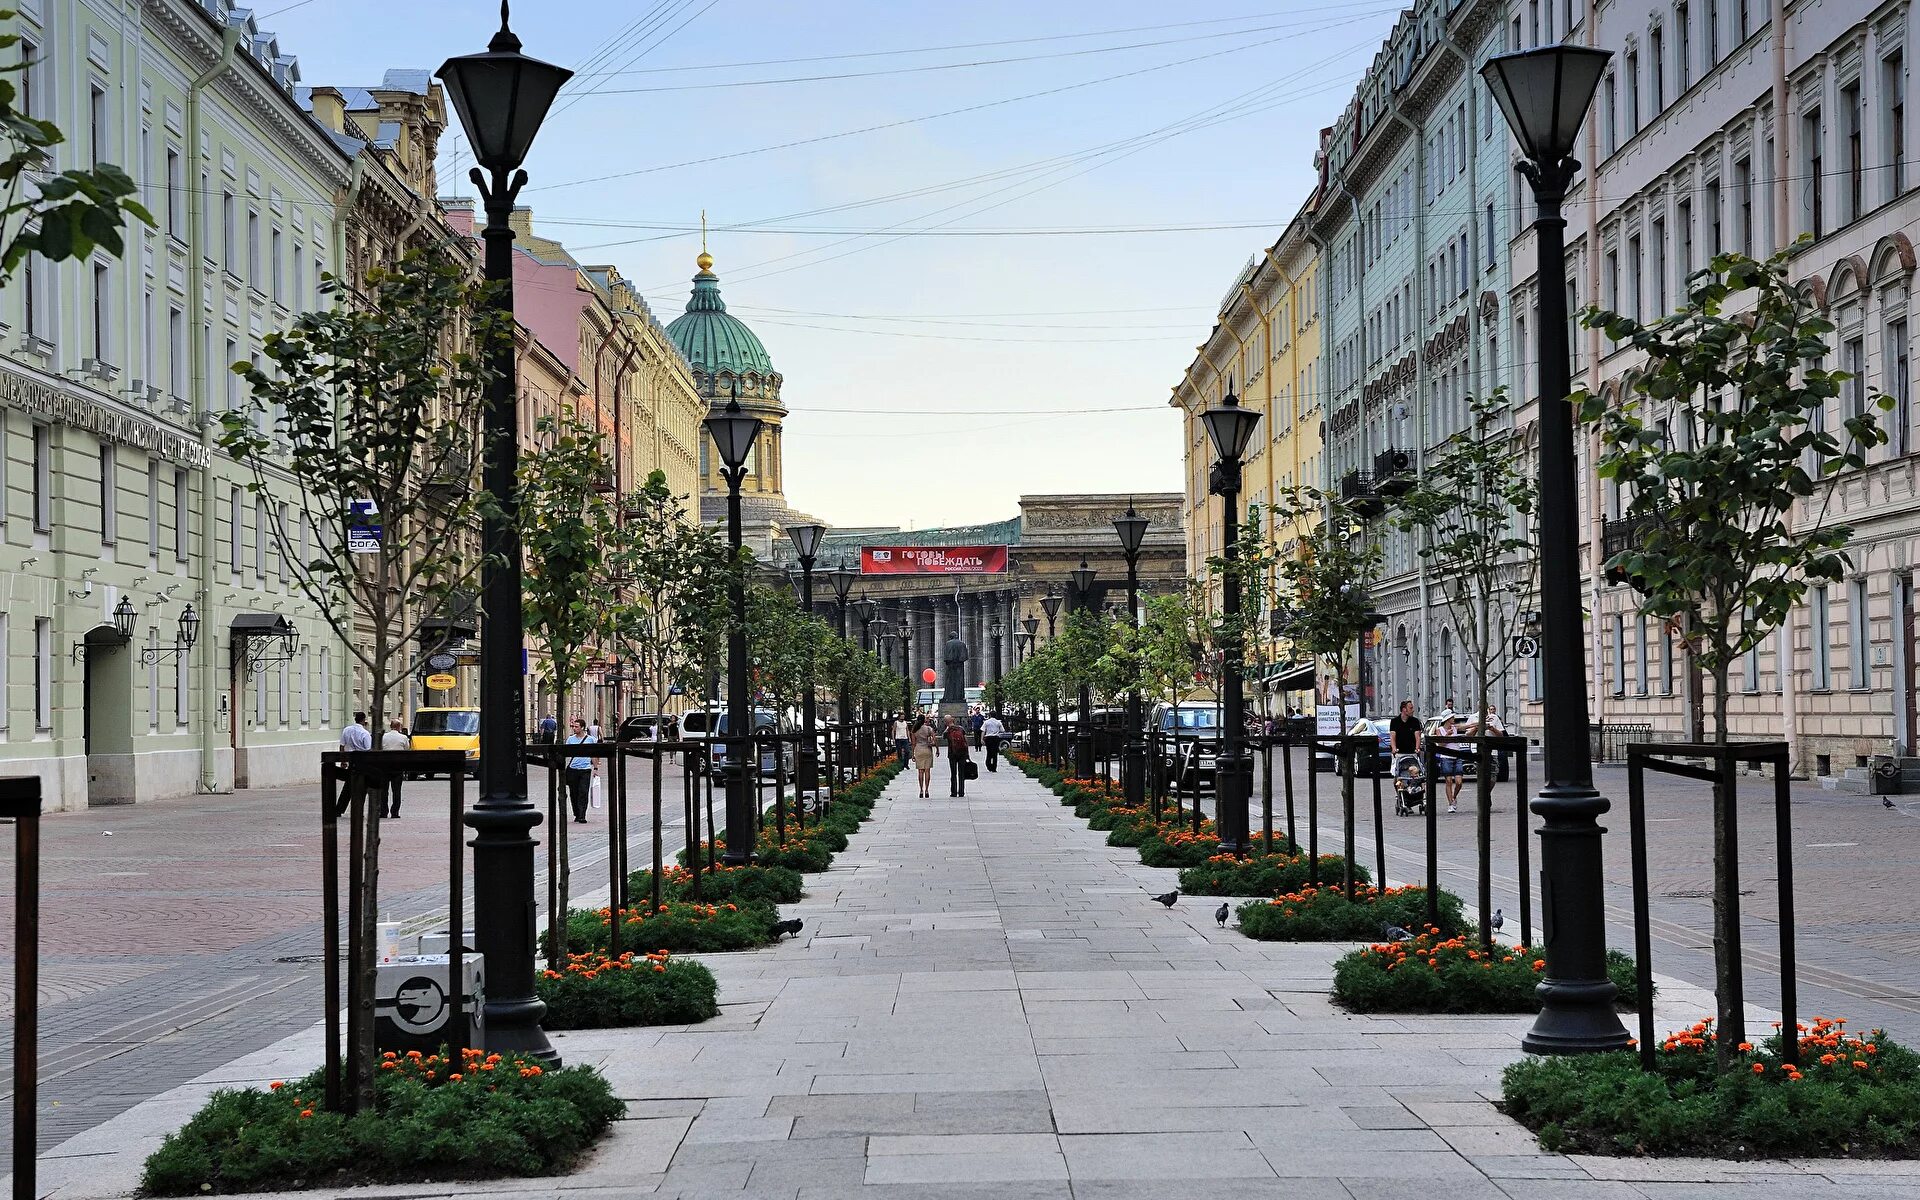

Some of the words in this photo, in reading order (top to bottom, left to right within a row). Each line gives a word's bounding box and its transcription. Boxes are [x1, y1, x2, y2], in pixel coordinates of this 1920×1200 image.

[0, 373, 96, 429] МЕЖДУНАРОДНЫЙ
[98, 407, 160, 452] МЕДИЦИНСКИЙ
[161, 430, 186, 460] ЦЕНТР
[350, 540, 379, 548] СОГА
[901, 550, 945, 559] ГОТОВЫ
[917, 557, 983, 567] ПОБЕЖДАТЬ
